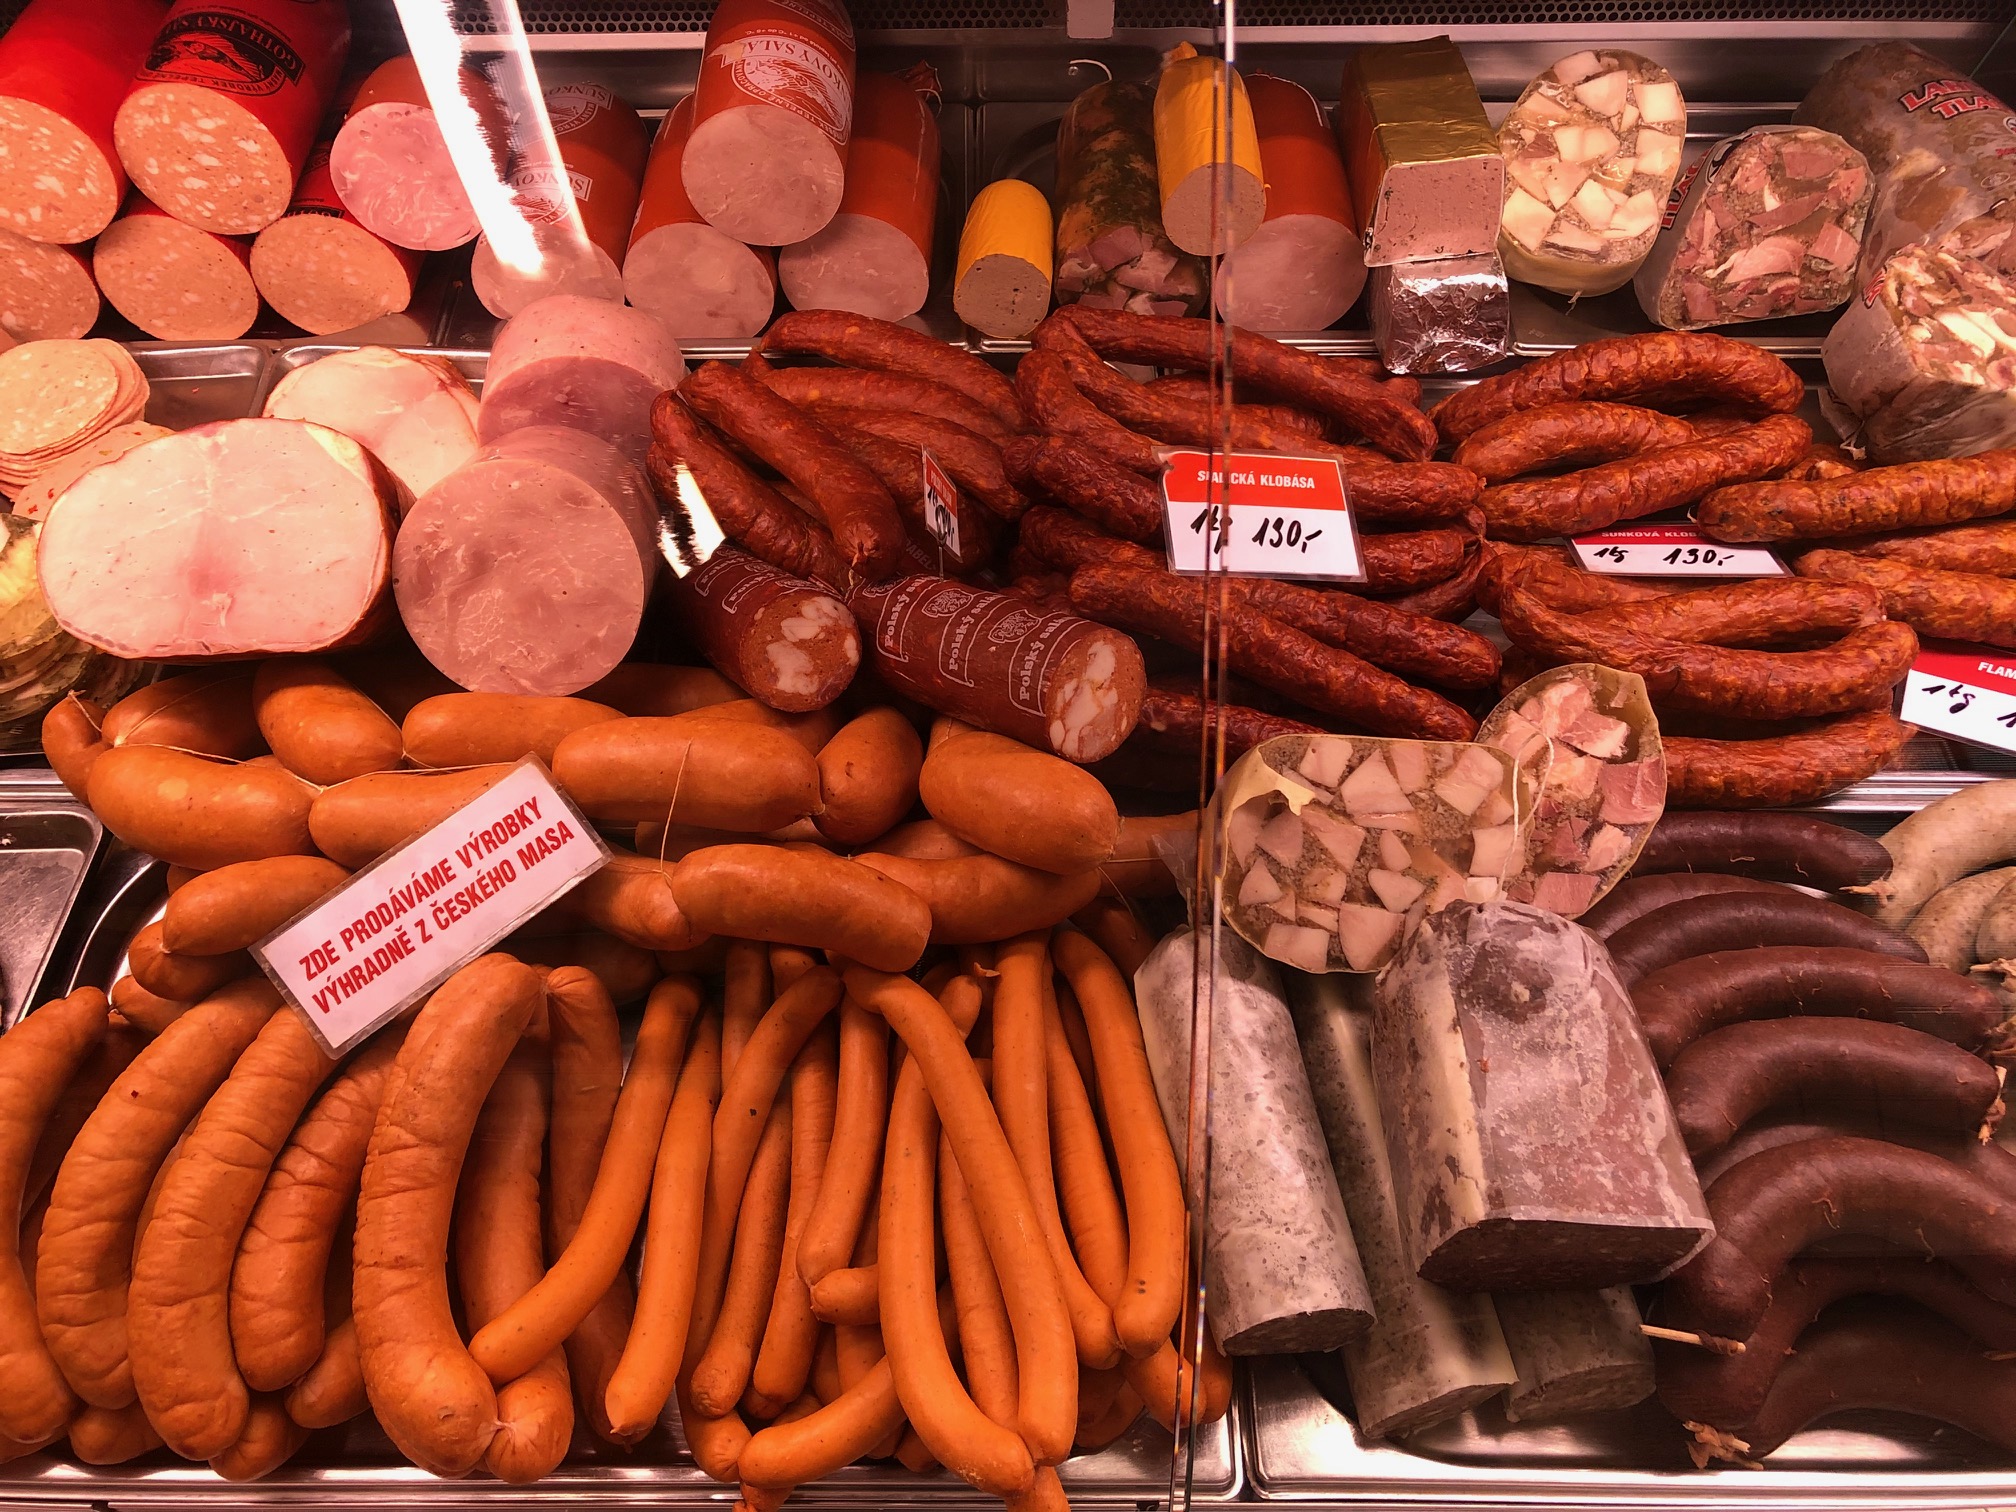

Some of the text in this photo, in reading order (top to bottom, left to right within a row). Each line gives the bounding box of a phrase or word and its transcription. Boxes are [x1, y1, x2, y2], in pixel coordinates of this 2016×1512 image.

[747, 41, 795, 56] SALÁ
[1260, 473, 1316, 489] KLOBÁSA
[884, 593, 911, 648] Polský
[948, 614, 976, 671] Polský
[1019, 639, 1046, 701] Polský
[299, 796, 542, 981] ZDE PRODÁVÁME VÝROBKY
[312, 820, 575, 1014] VÝHRADNĚ Z ČESKÉHO MASA
